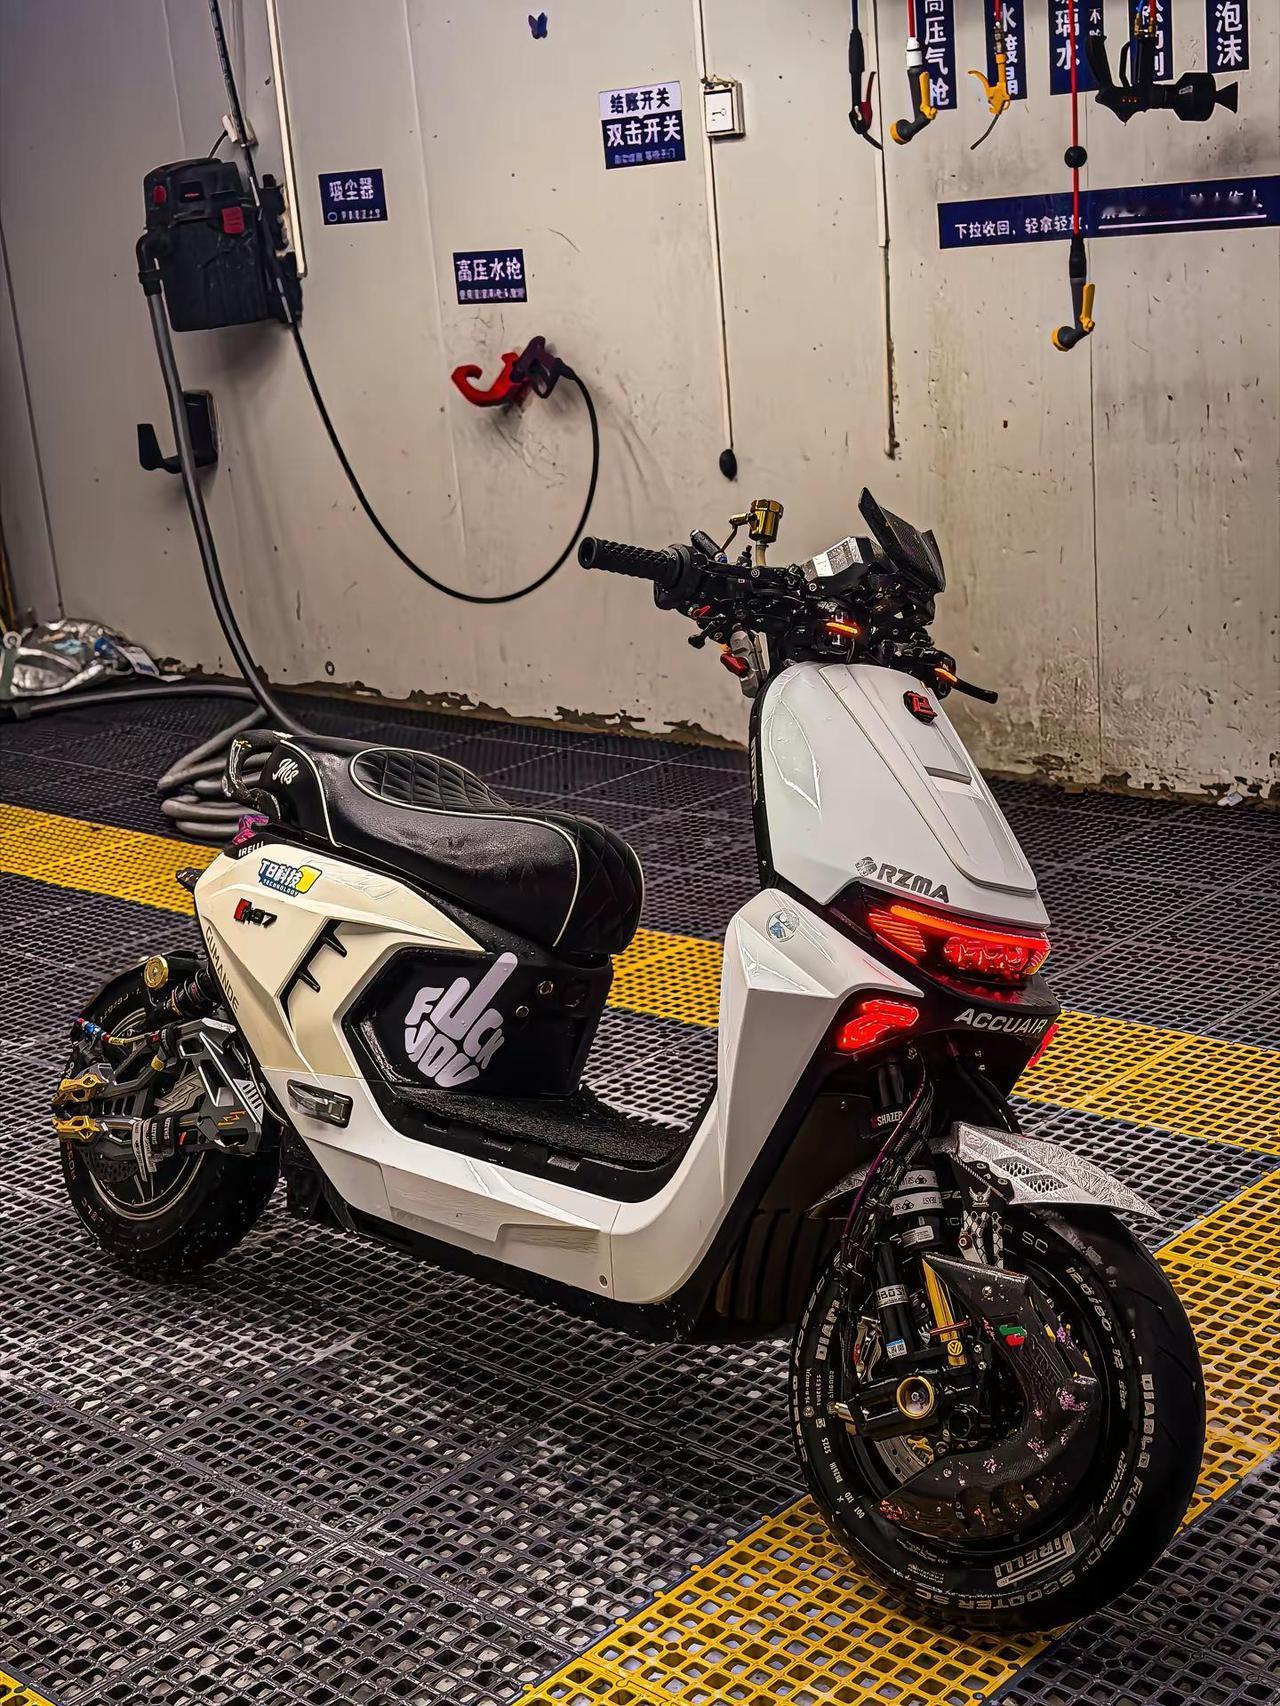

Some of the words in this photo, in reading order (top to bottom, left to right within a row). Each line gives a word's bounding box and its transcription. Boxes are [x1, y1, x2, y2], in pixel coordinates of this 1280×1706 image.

[1055, 0, 1080, 70] 璃水
[1215, 2, 1243, 66] 泡沫
[610, 87, 670, 114] 结账开关
[606, 114, 681, 147] 双击开关
[329, 177, 374, 202] 吸尘器
[456, 257, 522, 282] 高压水枪
[262, 879, 299, 896] TECHNOLOGY
[877, 863, 949, 903] RZMA
[205, 926, 239, 1013] GUMANDE
[404, 951, 518, 1069] FUCK
[954, 1008, 1048, 1034] ACCUAIR
[404, 1020, 480, 1088] YOU
[1136, 1374, 1155, 1469] DIABLO
[993, 1530, 1077, 1588] PIRELLI
[914, 1587, 950, 1605] SC
[958, 1569, 1076, 1610] SCOOTER
